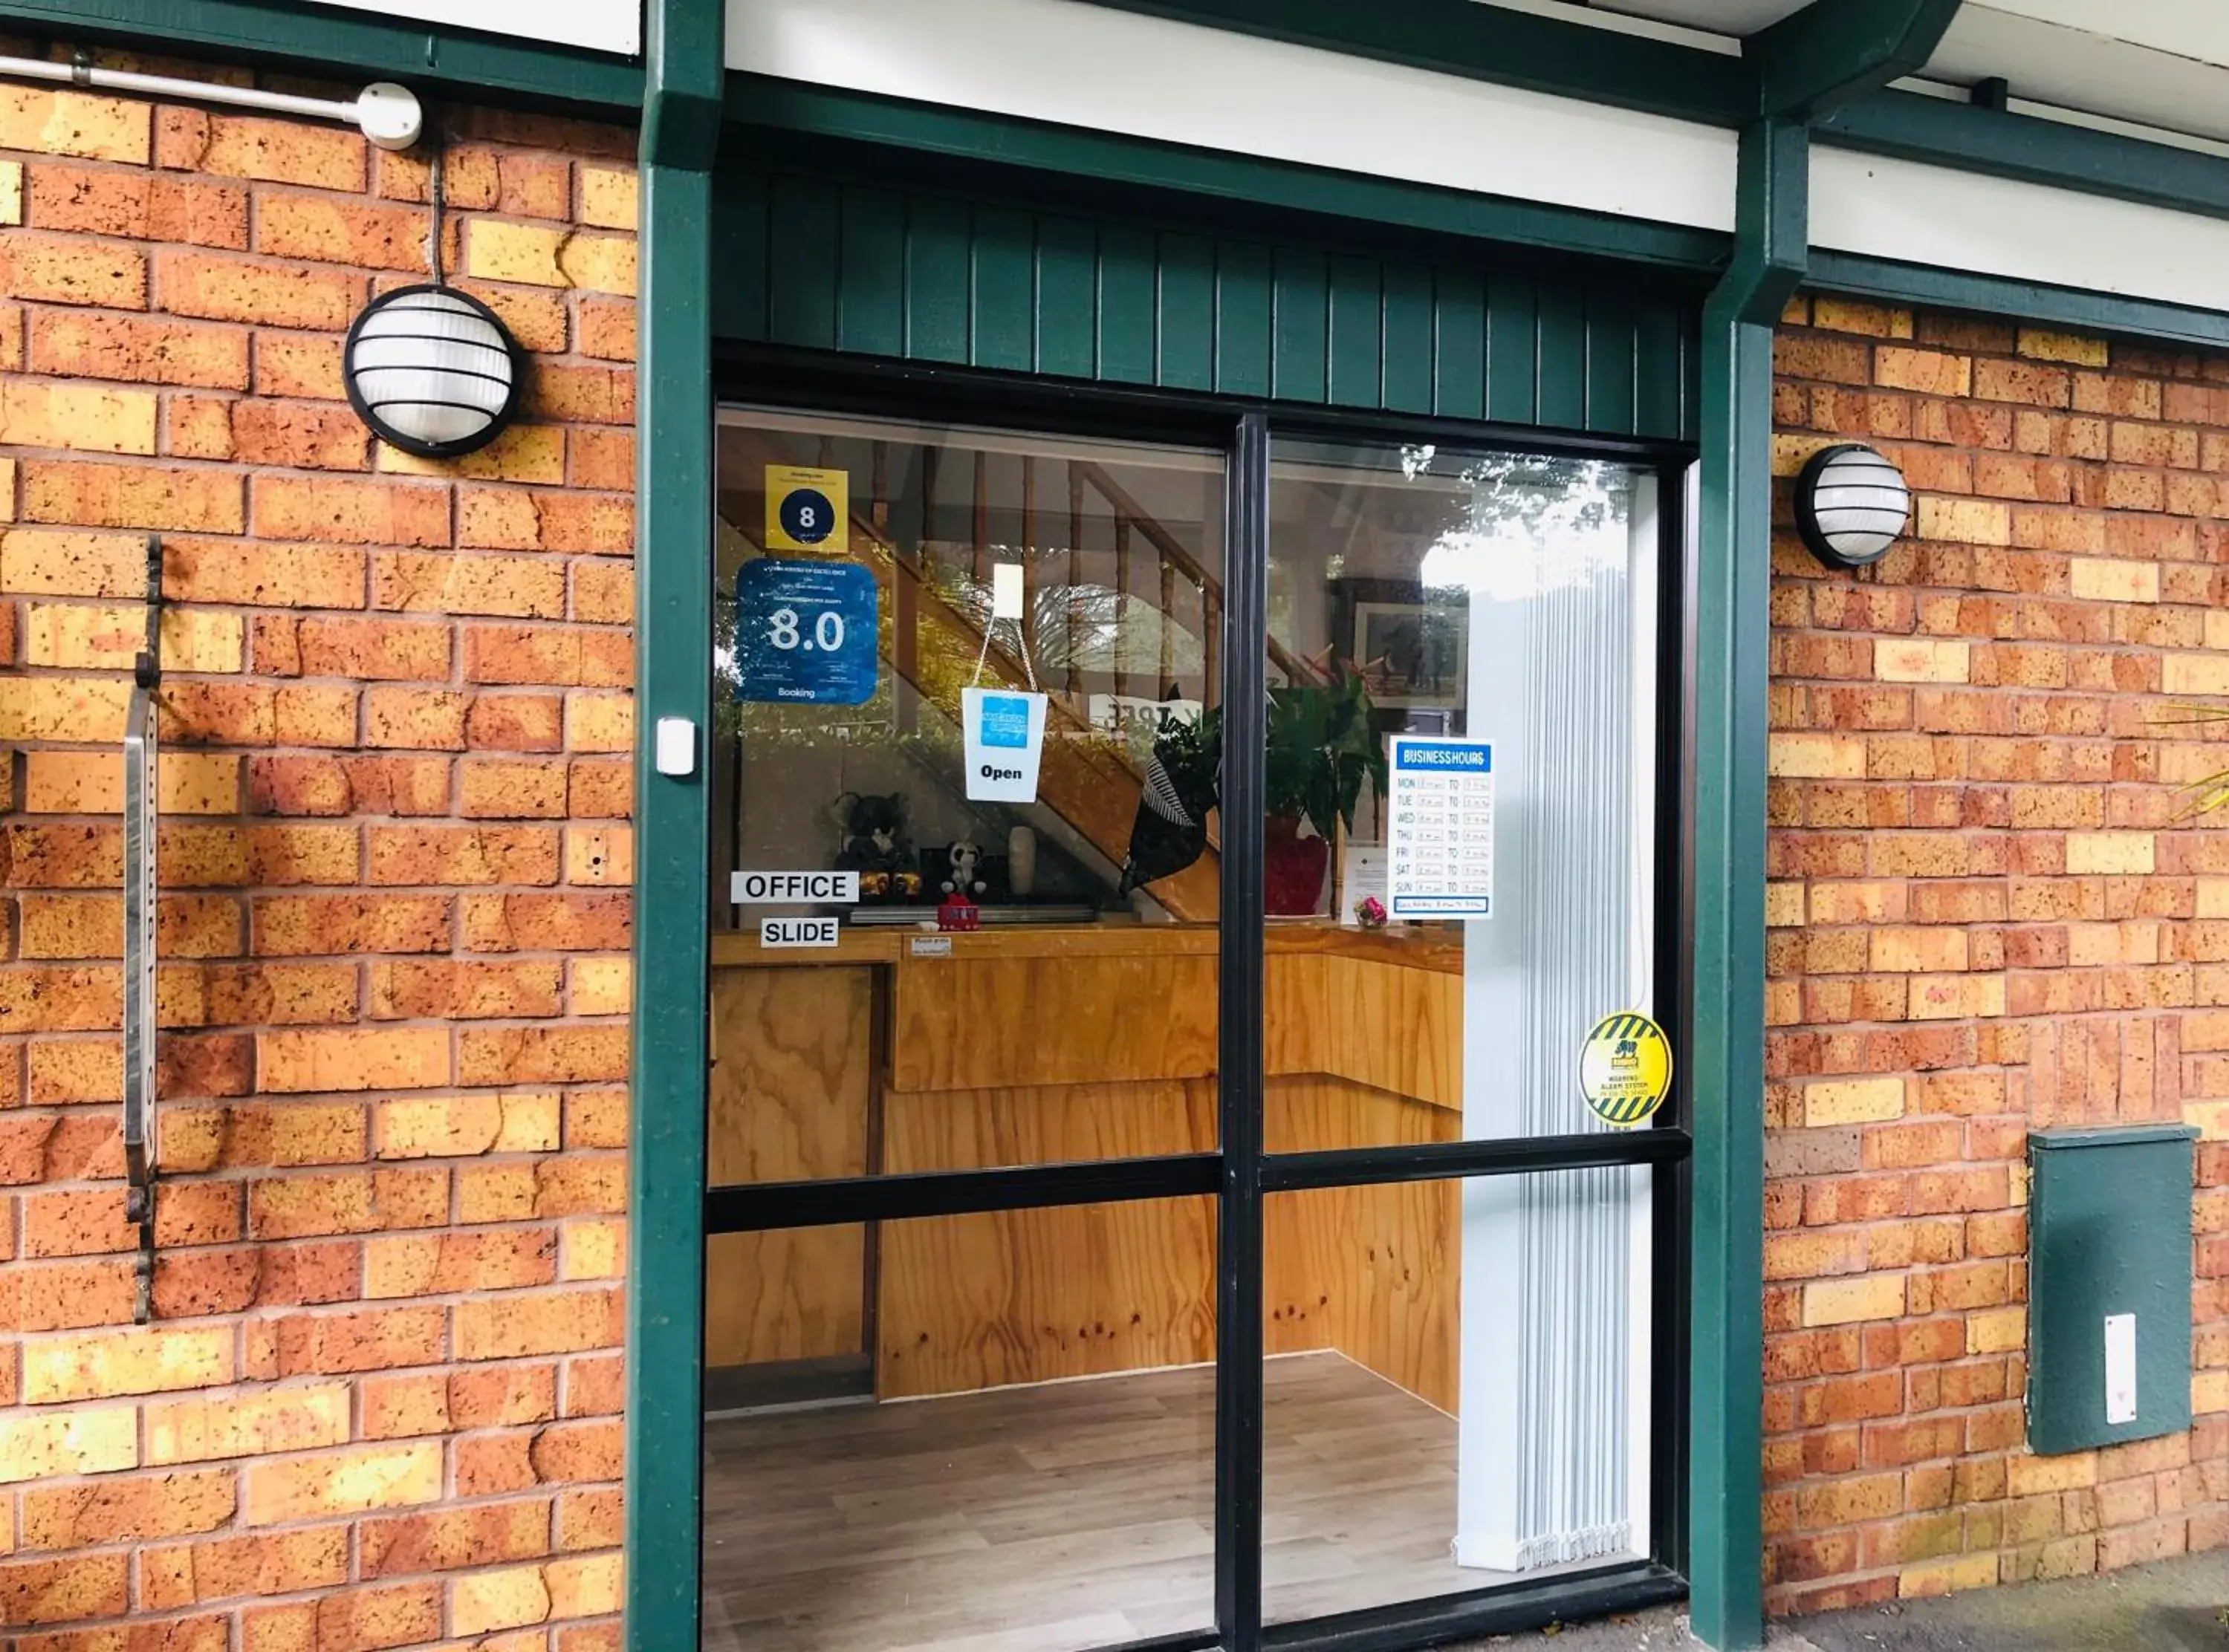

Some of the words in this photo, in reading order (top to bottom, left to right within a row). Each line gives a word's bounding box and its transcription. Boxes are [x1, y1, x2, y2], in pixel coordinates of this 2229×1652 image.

[799, 507, 815, 527] 8
[770, 608, 845, 651] 8.0
[777, 687, 815, 699] Booking
[1403, 749, 1451, 764] BUSINESS
[1451, 751, 1485, 766] HOURS
[981, 764, 1022, 781] Open
[1398, 778, 1415, 788] MON
[1450, 779, 1459, 790] TO
[1398, 795, 1412, 806] TUE
[1449, 796, 1459, 807] TO
[1398, 812, 1415, 824] WED
[1448, 813, 1459, 825] TO
[1397, 830, 1412, 841] THU
[1448, 830, 1459, 842] TO
[1396, 847, 1409, 858] FRI
[1448, 848, 1459, 859] TO
[1396, 863, 1410, 876] SAT
[1447, 865, 1458, 876] TO
[745, 875, 847, 898] OFFICE
[1395, 881, 1412, 893] SUN
[1447, 882, 1458, 893] TO
[765, 923, 834, 943] SLIDE
